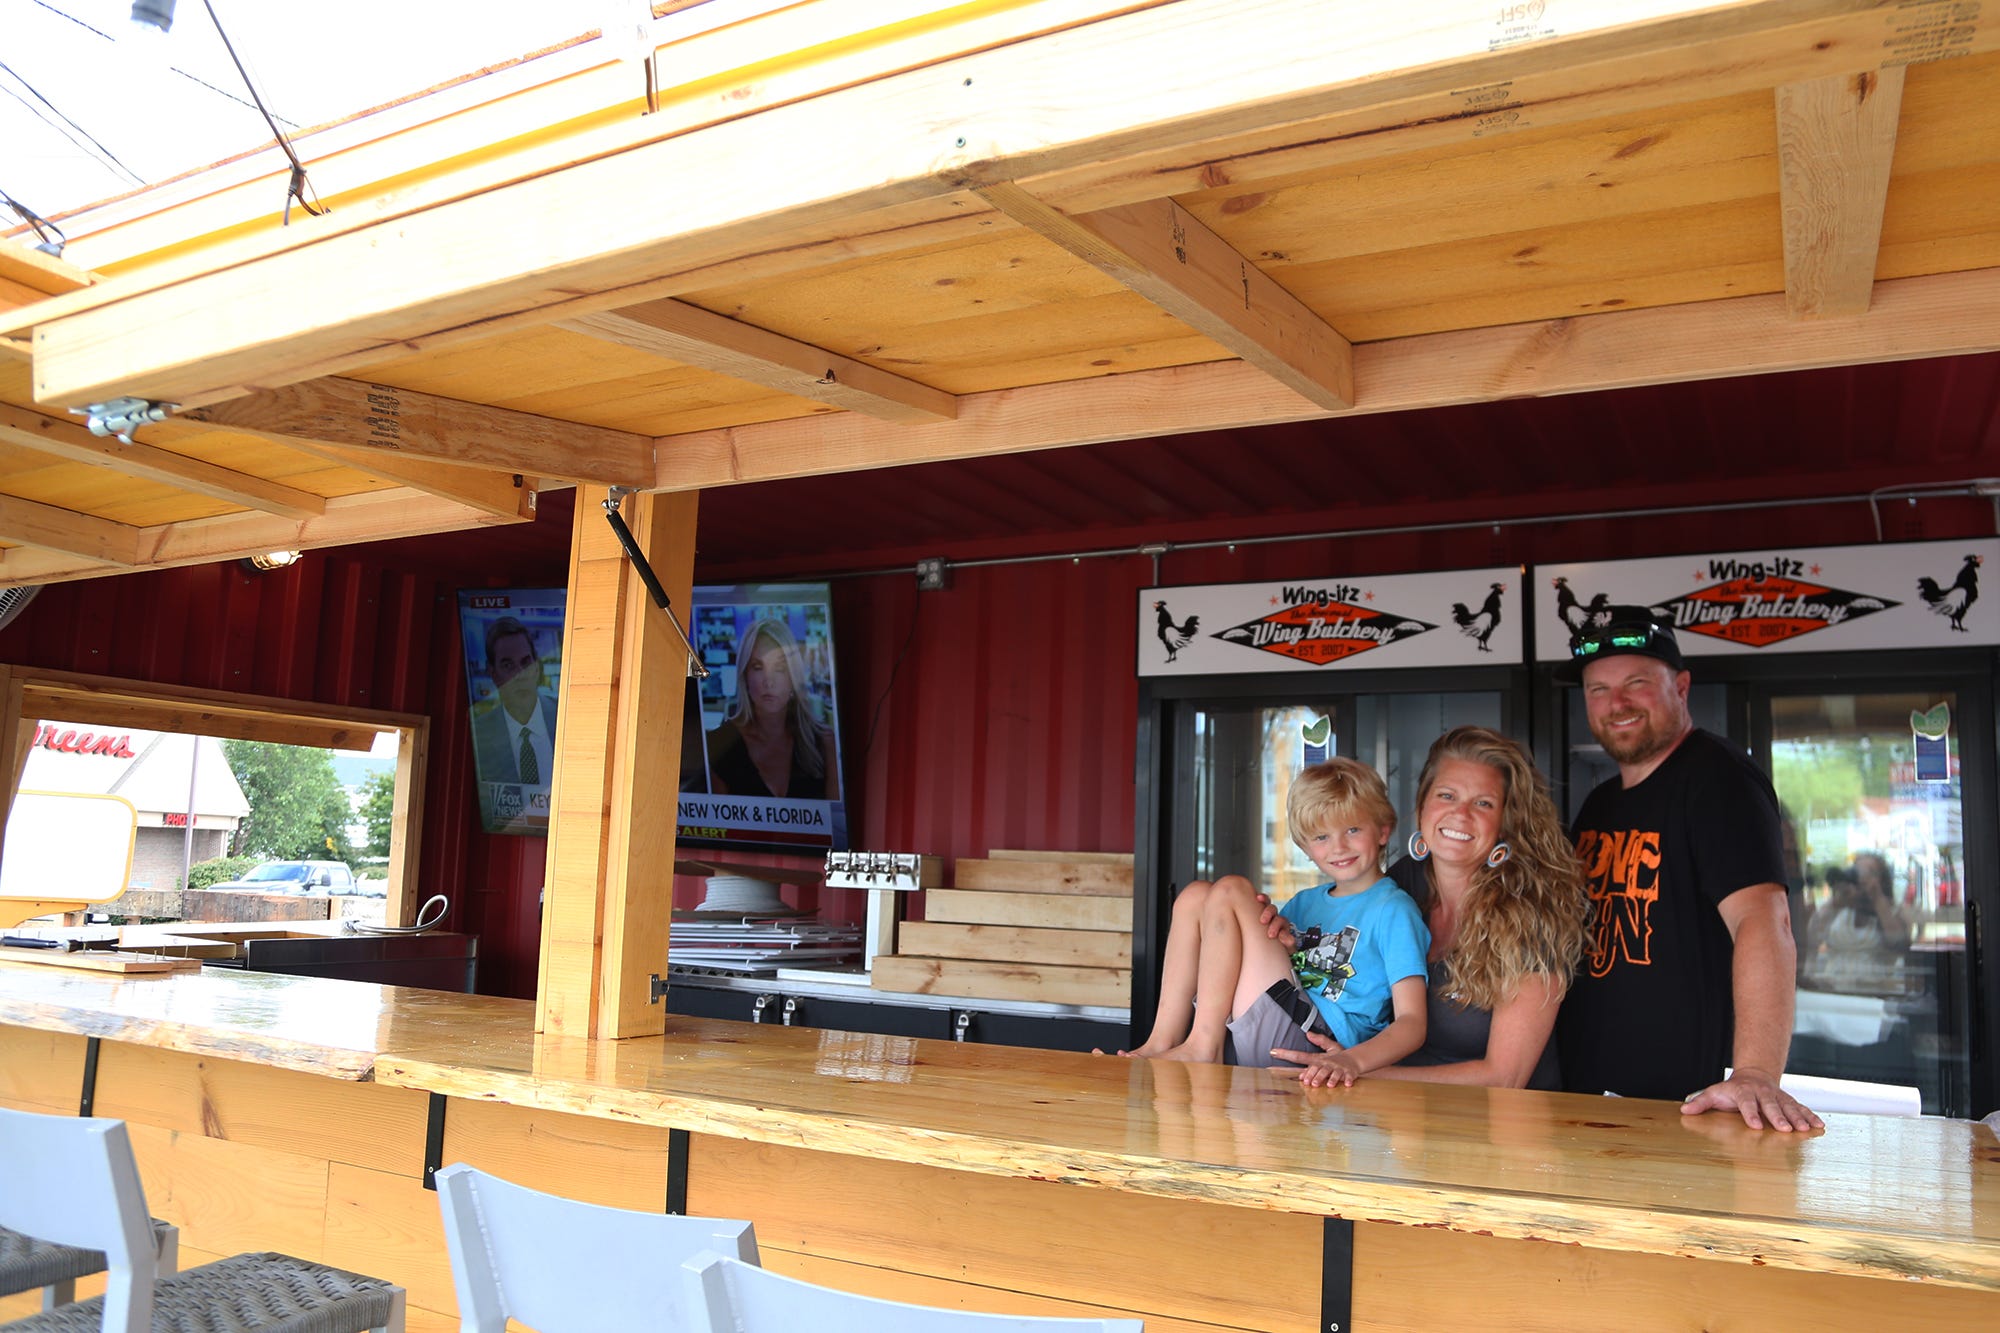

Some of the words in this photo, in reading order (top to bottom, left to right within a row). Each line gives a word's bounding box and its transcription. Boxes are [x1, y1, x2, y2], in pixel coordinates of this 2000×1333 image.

[1709, 556, 1804, 583] Wing-itz
[475, 597, 505, 608] LIVE
[1282, 584, 1360, 608] Wing-itz
[1670, 598, 1738, 626] Wing
[1739, 594, 1848, 624] Butchery
[1250, 621, 1305, 646] Wing
[1306, 617, 1396, 645] Butchery
[1731, 626, 1750, 638] EST
[1298, 645, 1315, 657] EST
[1321, 643, 1345, 656] 2007
[501, 794, 521, 806] FOX
[497, 805, 524, 816] NEWS
[678, 801, 709, 819] NEW
[712, 804, 750, 822] YORK
[752, 806, 763, 822] &
[766, 807, 824, 826] FLORIDA
[165, 813, 198, 826] PHO
[682, 825, 728, 839] ALERT
